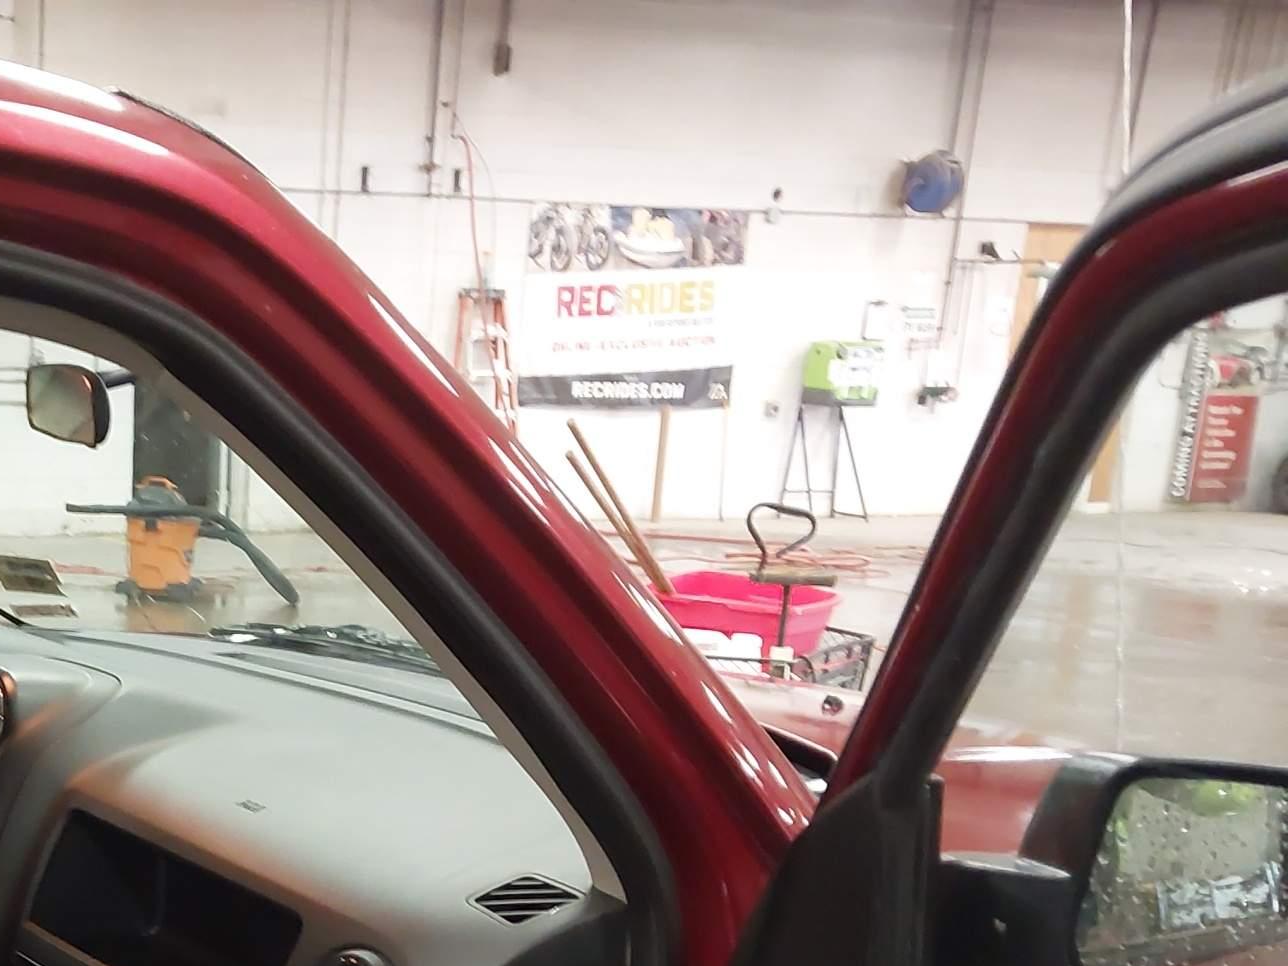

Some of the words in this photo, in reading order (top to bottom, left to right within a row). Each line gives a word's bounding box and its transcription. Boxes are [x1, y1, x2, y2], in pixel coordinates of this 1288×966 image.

[557, 284, 616, 318] REC
[624, 281, 714, 315] RIDES
[571, 380, 686, 400] RECRIDES.COM
